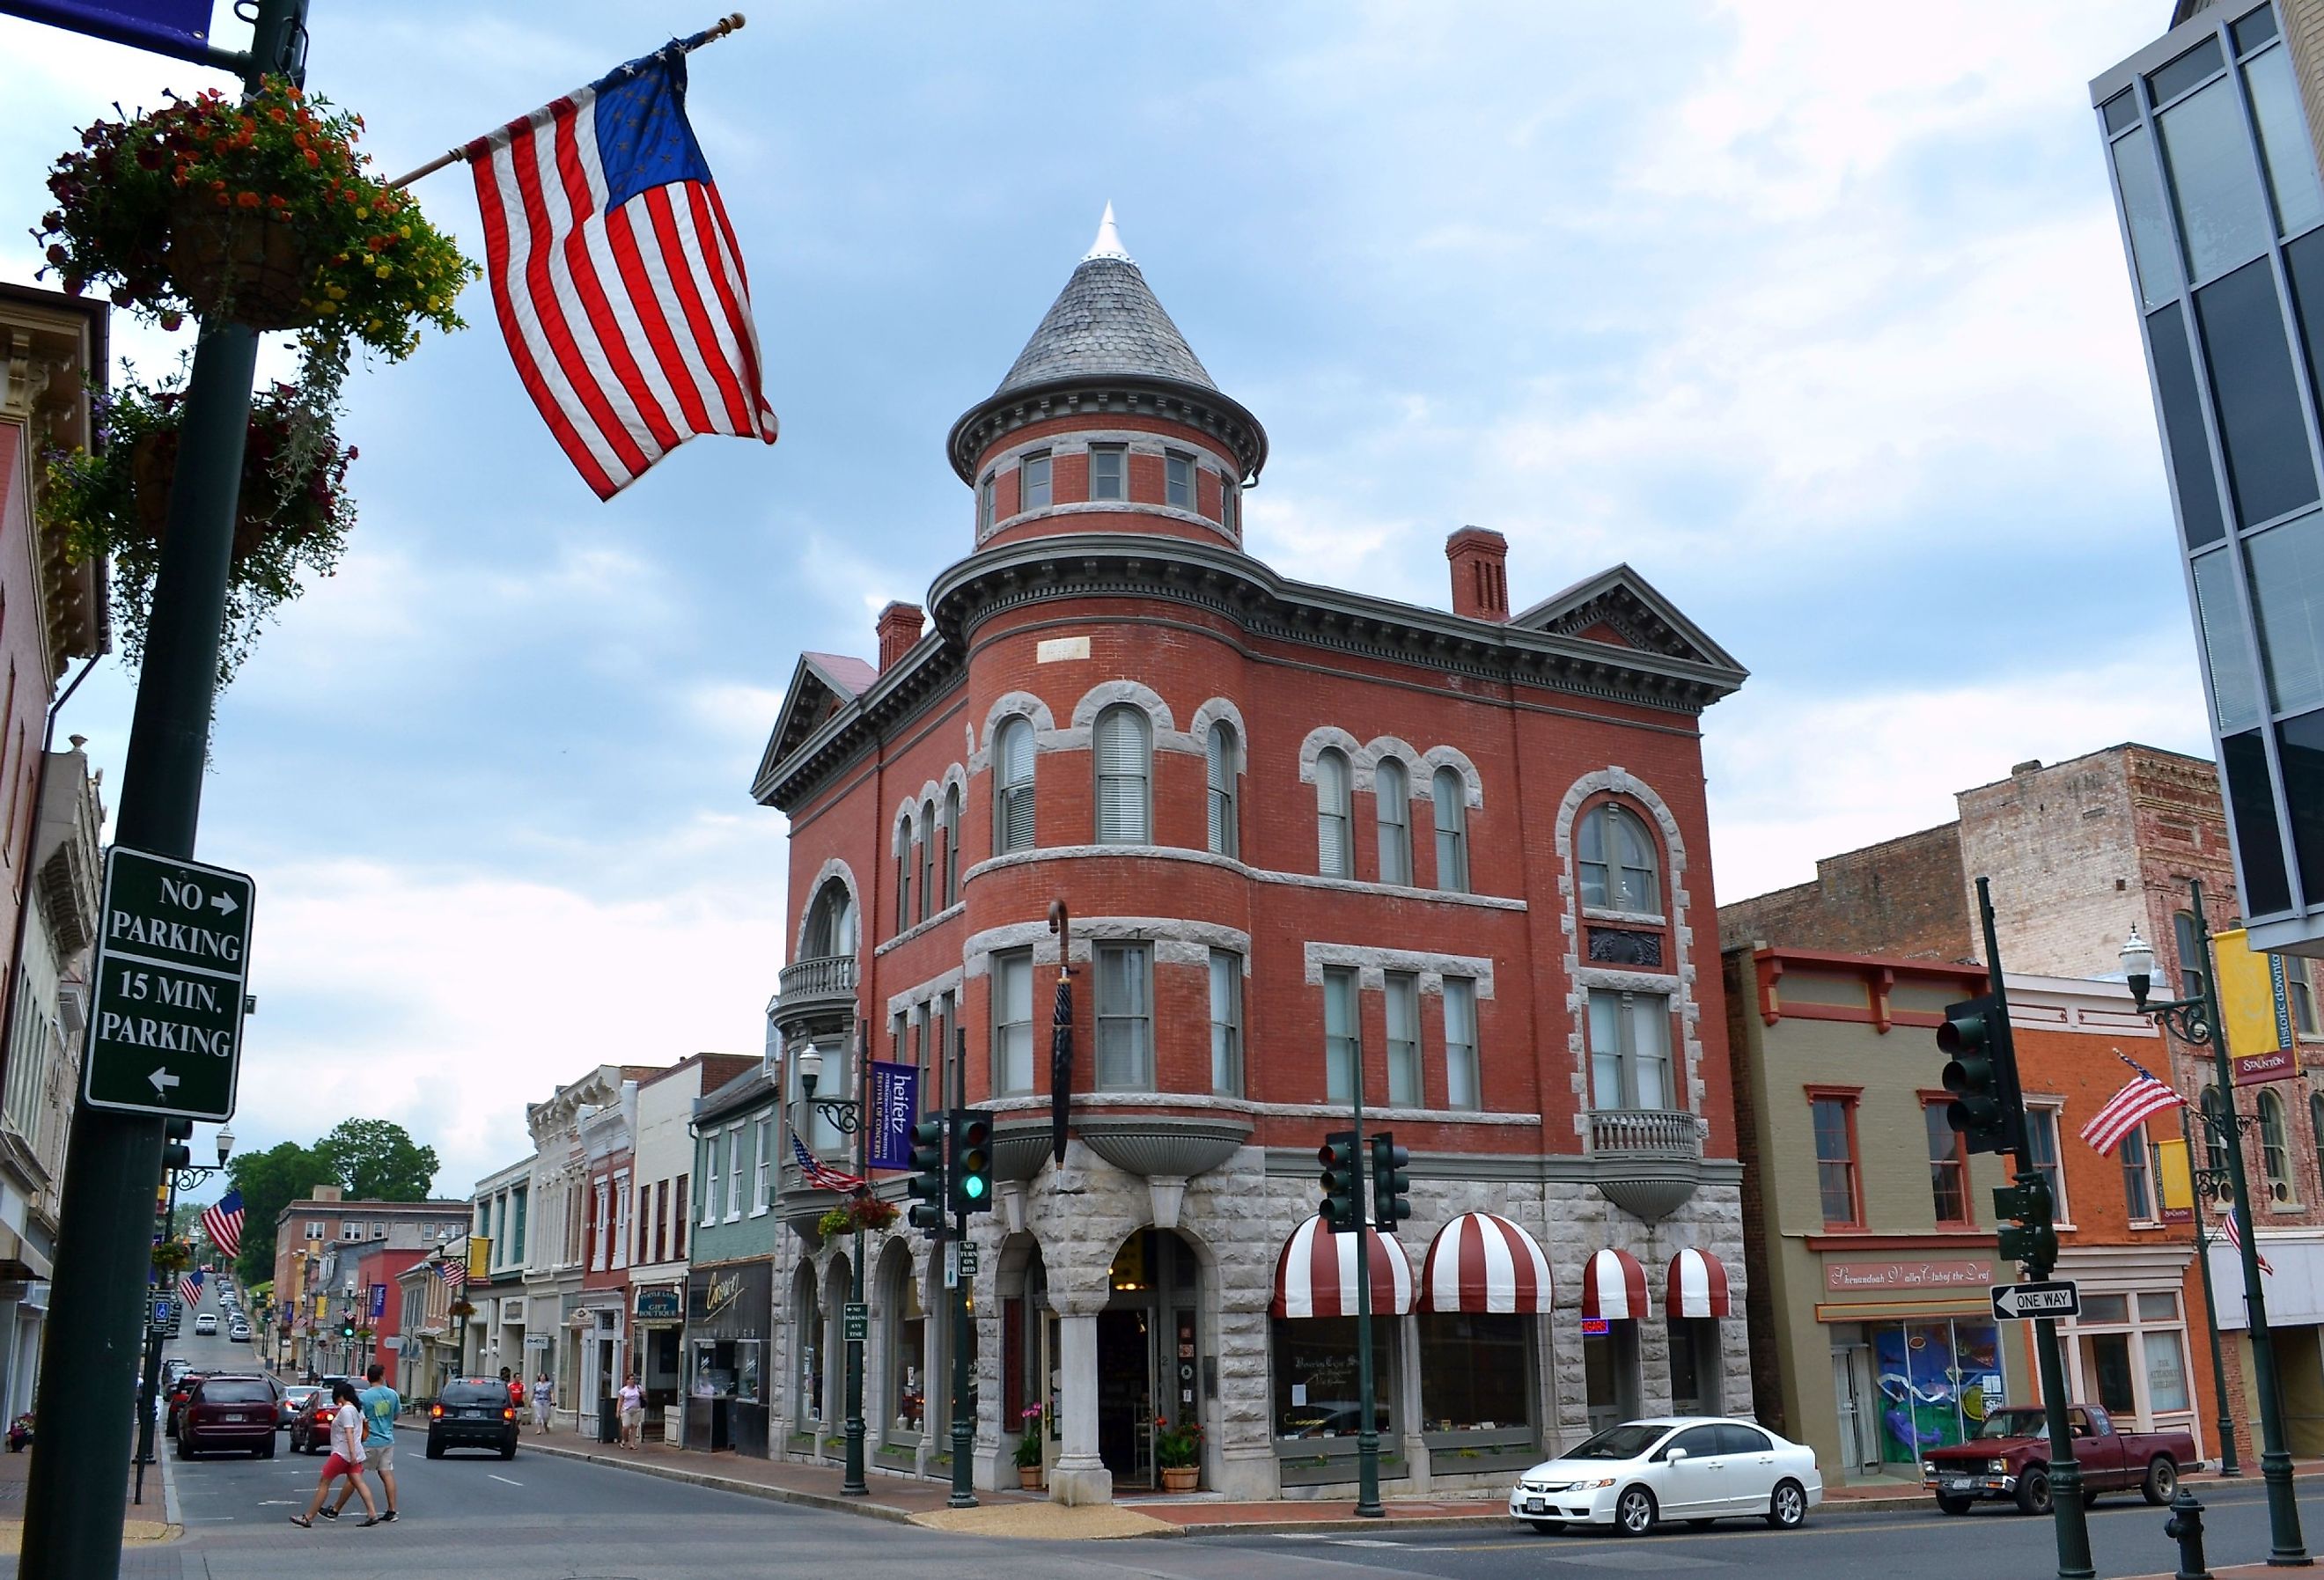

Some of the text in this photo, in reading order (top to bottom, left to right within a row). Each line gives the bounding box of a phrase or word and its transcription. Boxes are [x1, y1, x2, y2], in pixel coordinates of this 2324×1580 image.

[158, 877, 202, 910] NO
[110, 909, 240, 961] PARKING
[120, 970, 223, 1014] 15 MIN.
[2272, 954, 2291, 1048] historic downto
[99, 1011, 232, 1057] PARKING
[876, 1107, 883, 1117] OF
[893, 1075, 912, 1135] heifetz
[874, 1119, 883, 1159] CONCERTS
[1832, 1267, 1884, 1285] Shenandoah
[1888, 1266, 1921, 1285] Valley
[1953, 1270, 1964, 1281] the
[1966, 1263, 1989, 1282] Deaf
[2017, 1291, 2067, 1308] ONE WAY
[1583, 1320, 1607, 1332] IGARS
